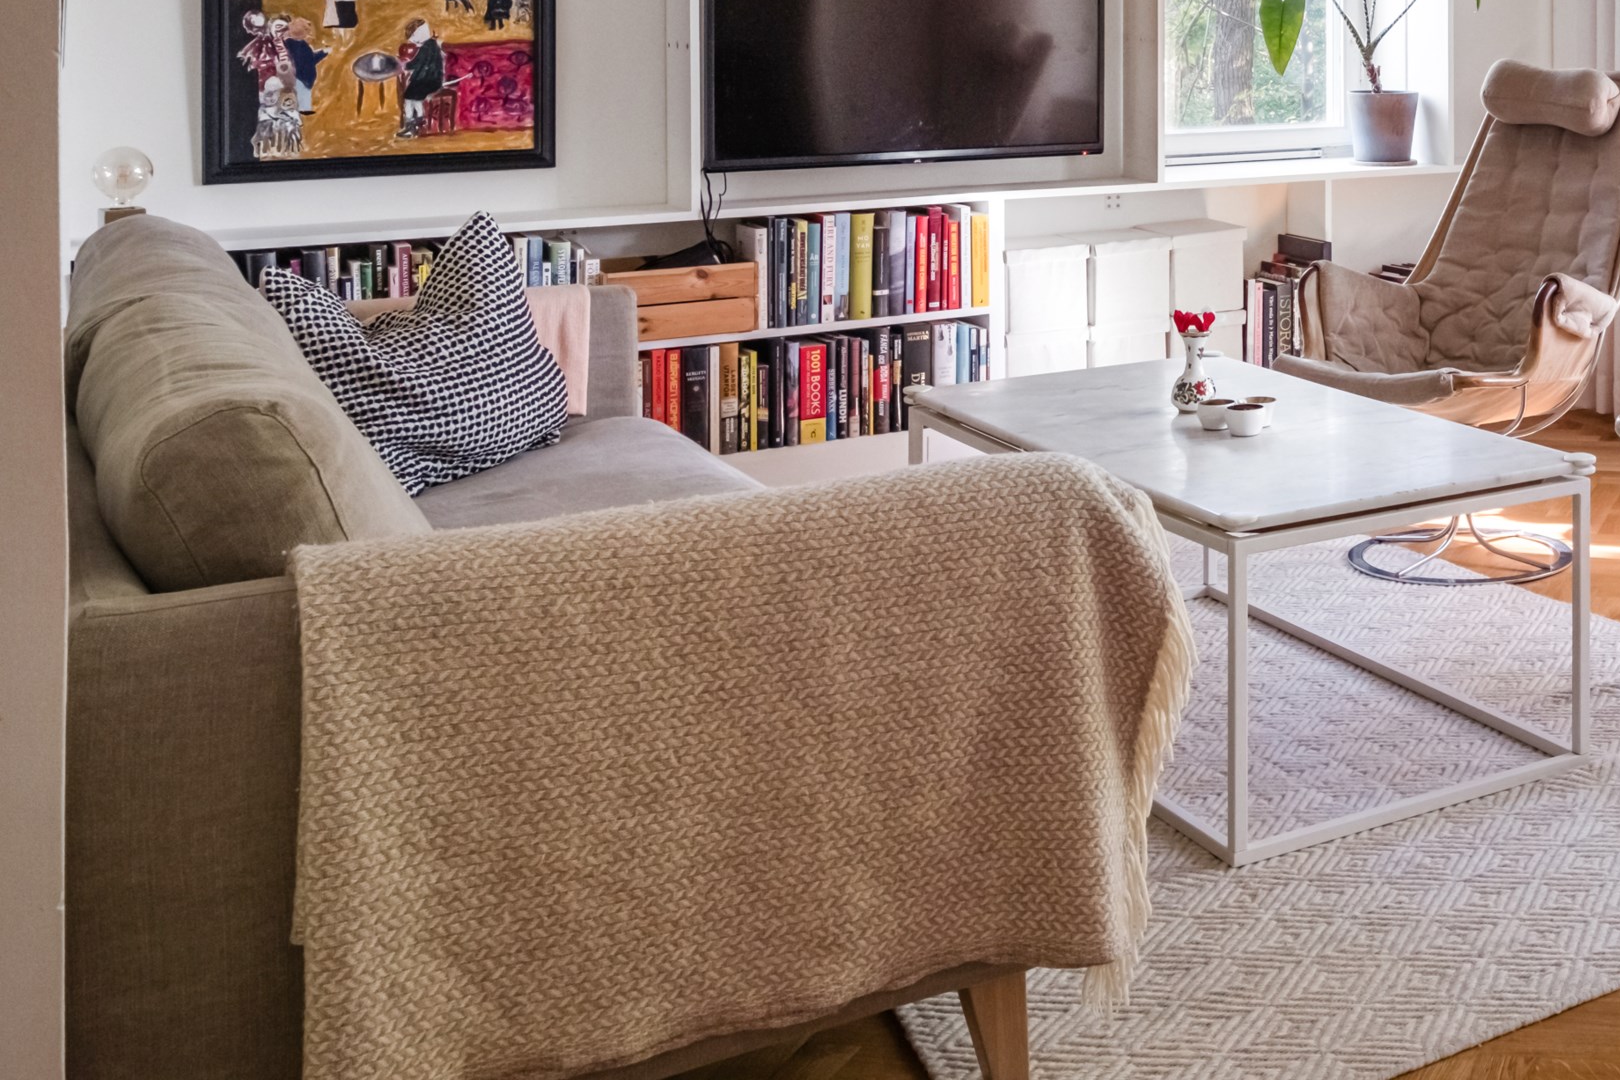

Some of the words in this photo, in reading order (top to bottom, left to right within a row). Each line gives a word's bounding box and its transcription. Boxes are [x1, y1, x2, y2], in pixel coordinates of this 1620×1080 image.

[826, 220, 834, 239] FIRE
[826, 244, 834, 263] AND
[826, 266, 834, 288] FURY
[1280, 298, 1291, 352] STORA
[812, 349, 820, 373] 1001
[880, 366, 889, 382] DÖDA
[812, 376, 820, 415] BOOKS
